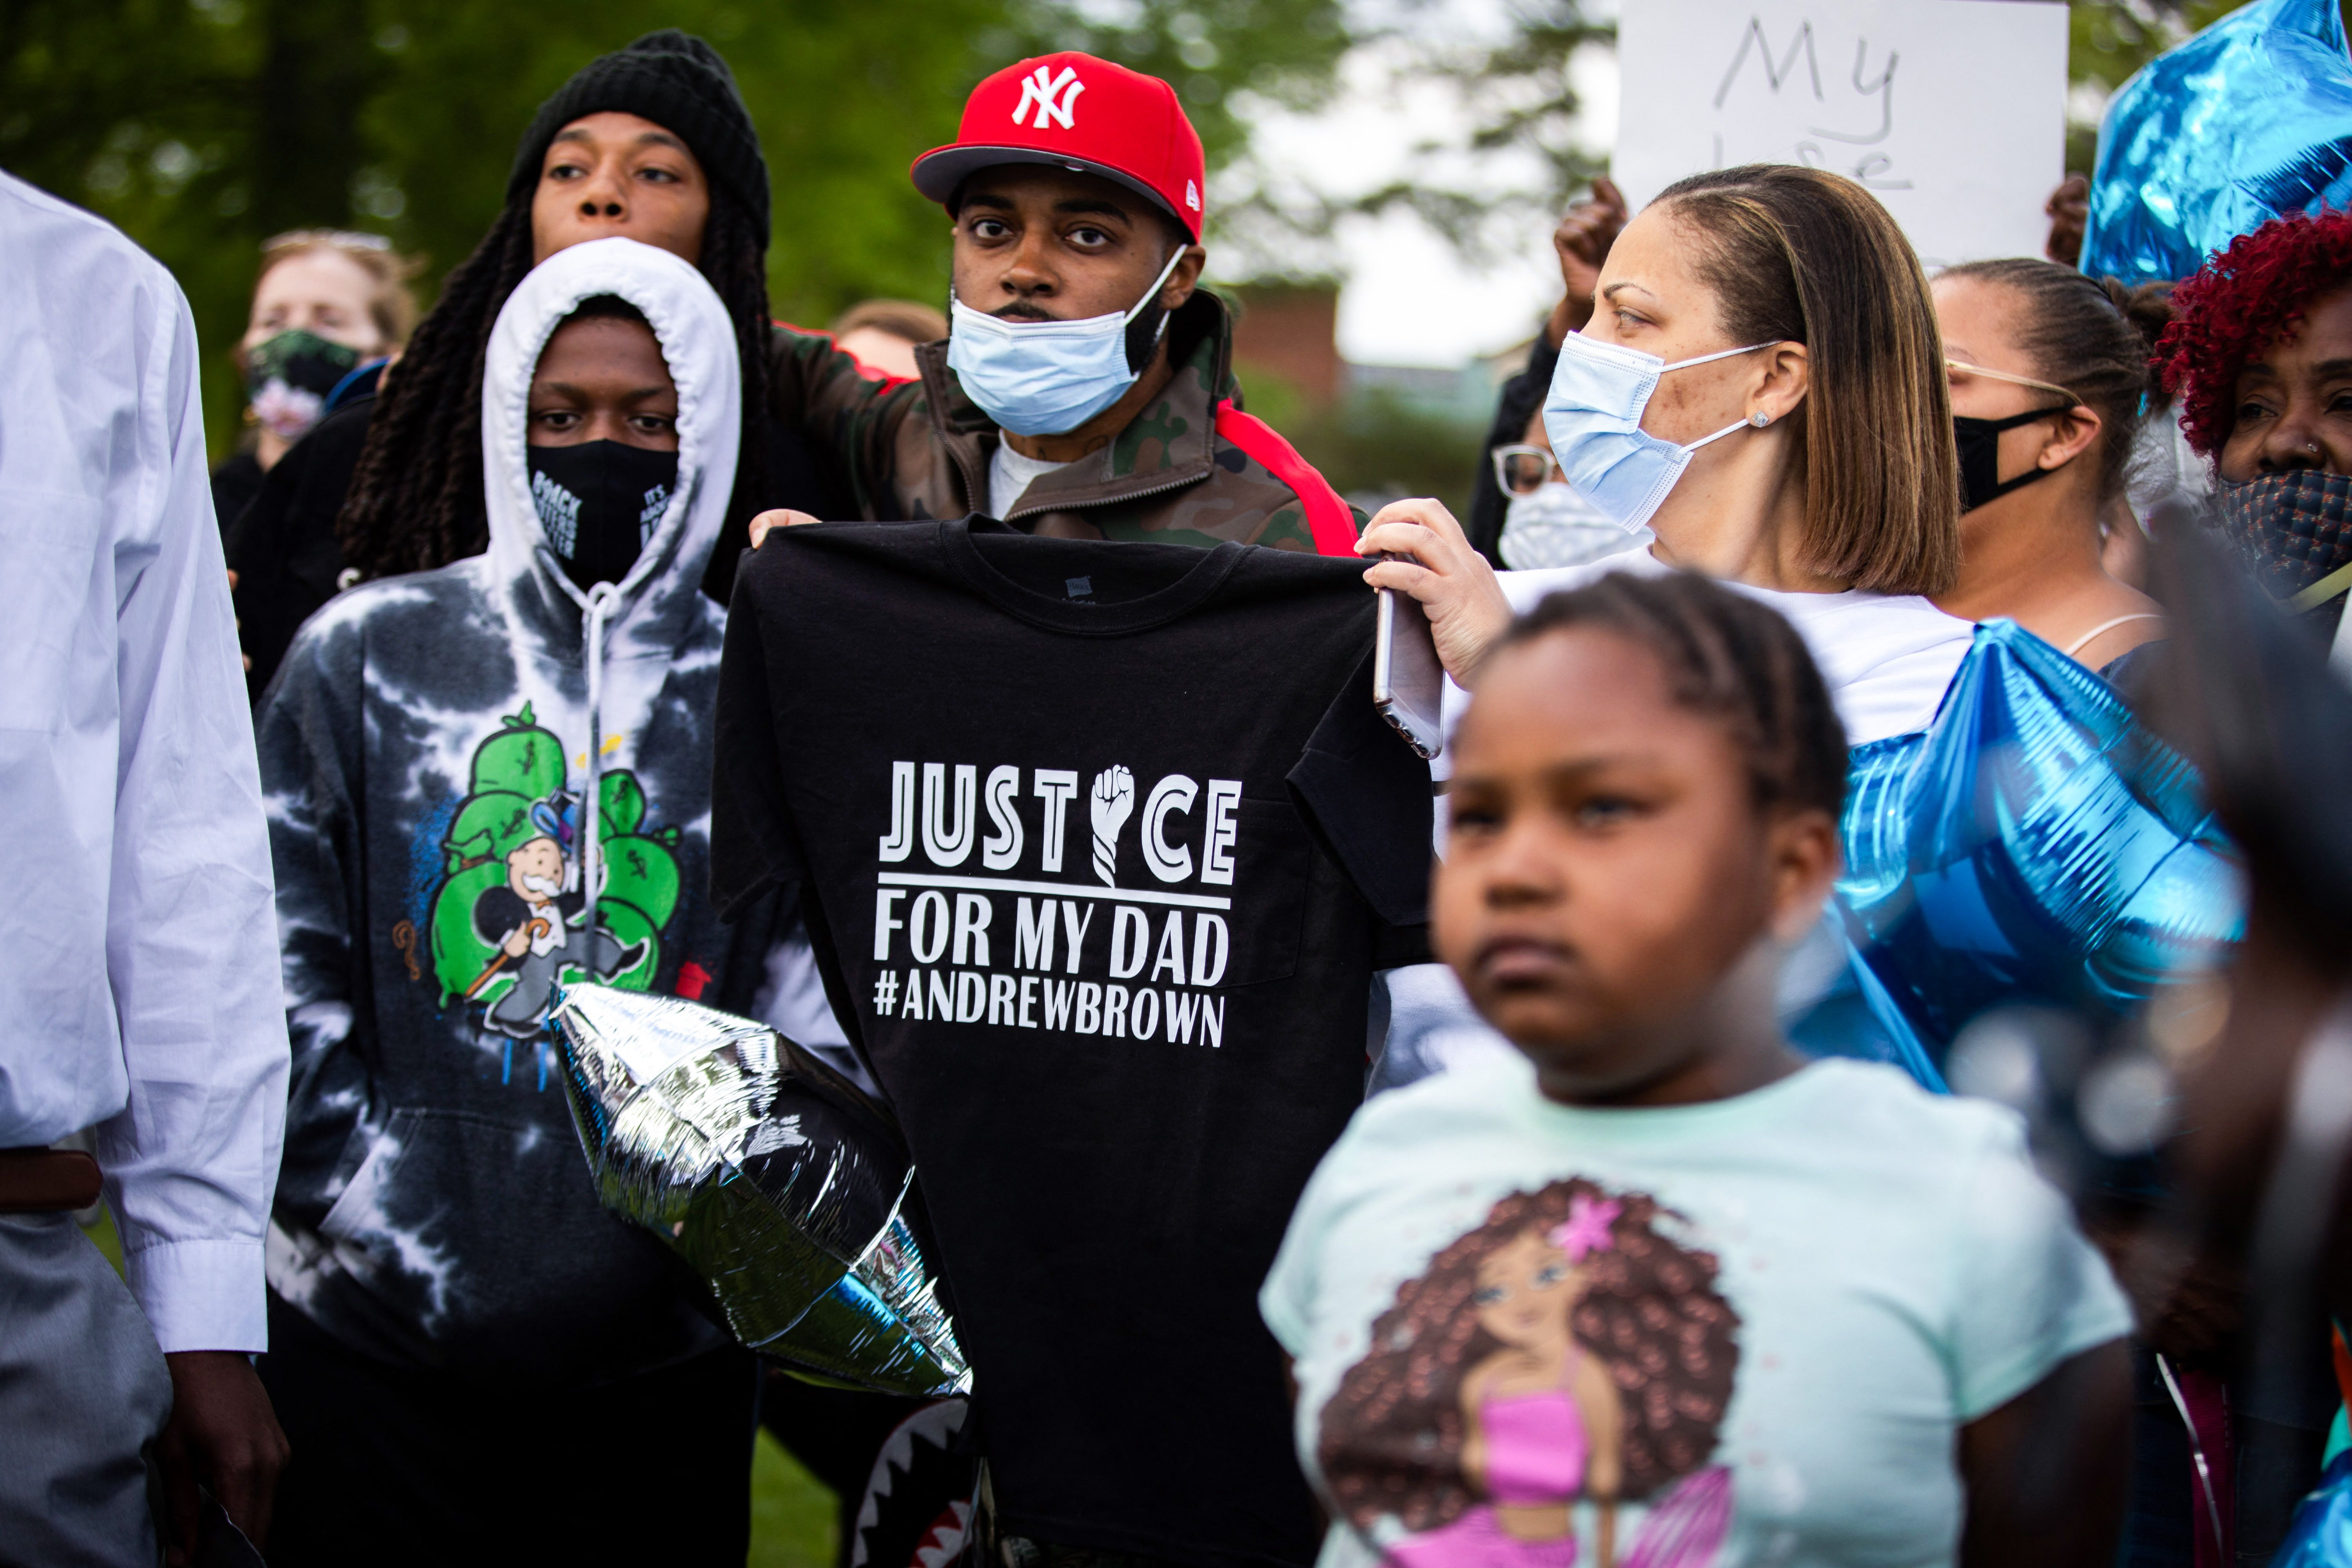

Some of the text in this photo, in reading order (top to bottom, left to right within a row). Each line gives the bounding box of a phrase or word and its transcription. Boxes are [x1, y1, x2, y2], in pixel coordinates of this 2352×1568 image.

[1012, 65, 1086, 130] NY
[1713, 14, 1901, 145] My
[874, 889, 1229, 987] FOR MY DAD
[873, 969, 1225, 1048] #ANDREWBROWN
